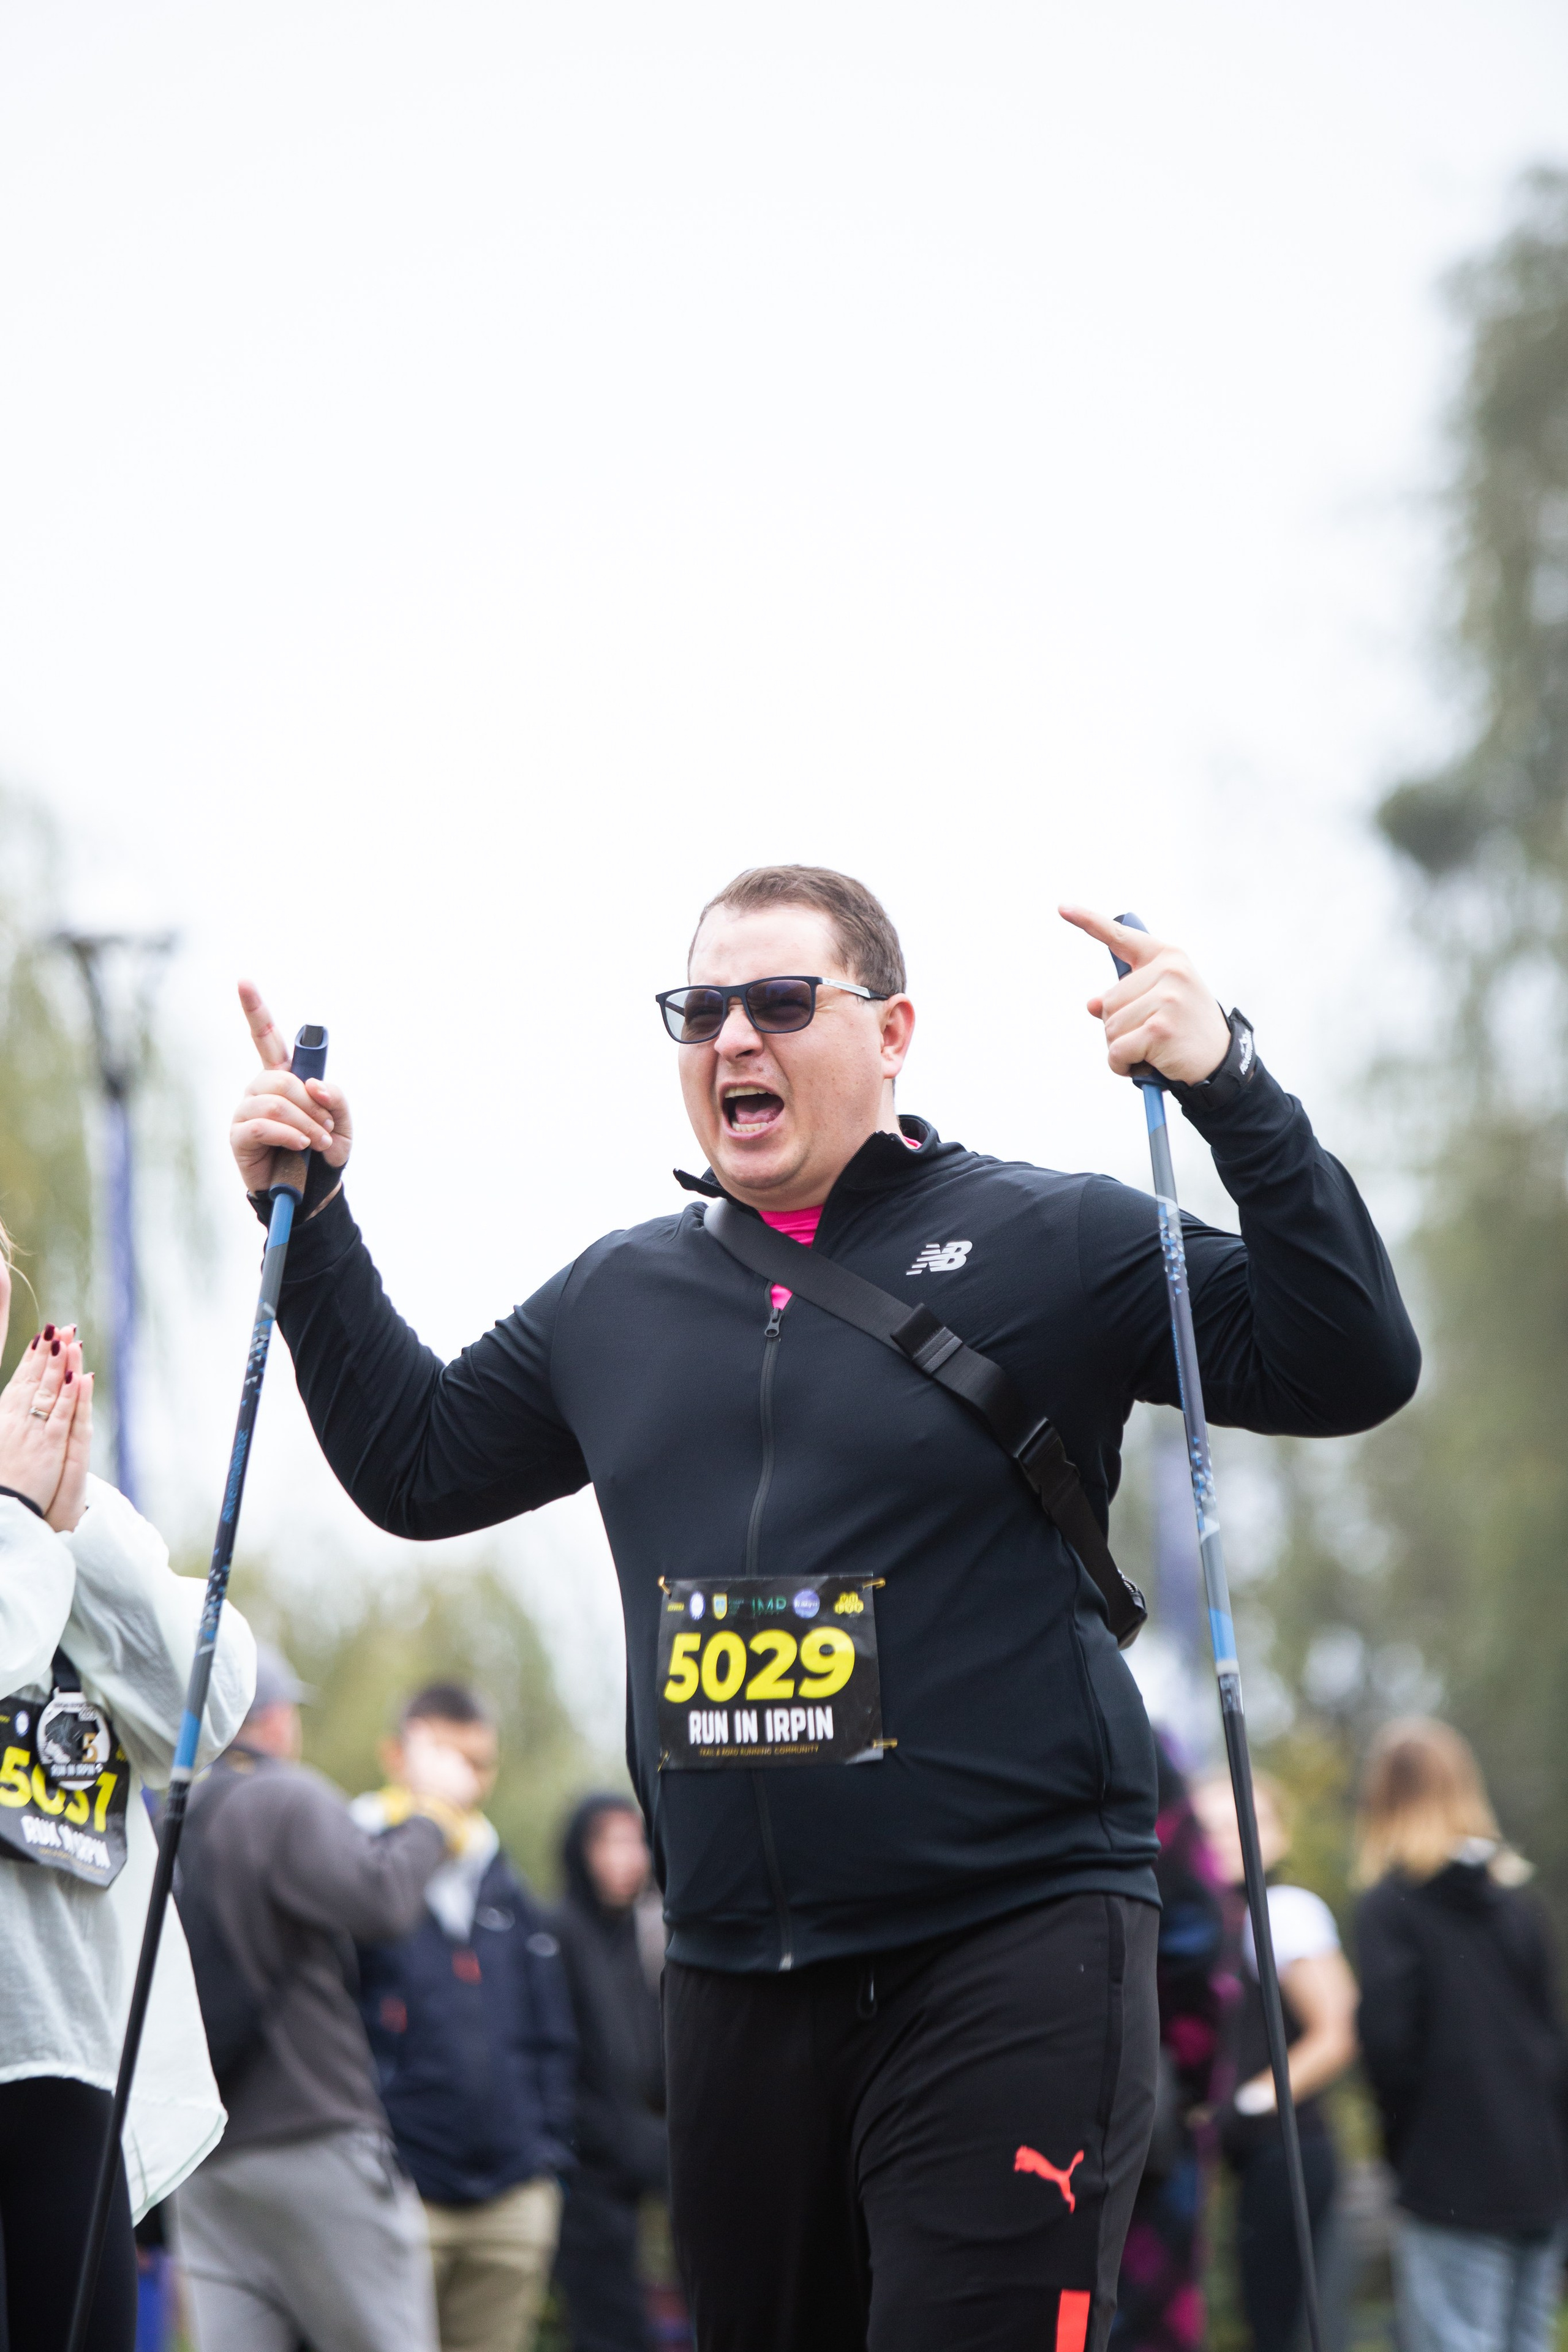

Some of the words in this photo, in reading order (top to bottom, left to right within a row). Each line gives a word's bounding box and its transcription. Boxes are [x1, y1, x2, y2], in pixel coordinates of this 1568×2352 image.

[905, 1240, 973, 1276] NB
[664, 1626, 856, 1703] 5029
[688, 1709, 729, 1745] RUN
[734, 1708, 759, 1744] IN
[764, 1705, 834, 1743] IRPIN
[741, 1746, 772, 1756] RUNNING
[774, 1744, 819, 1755] COMMUNITY
